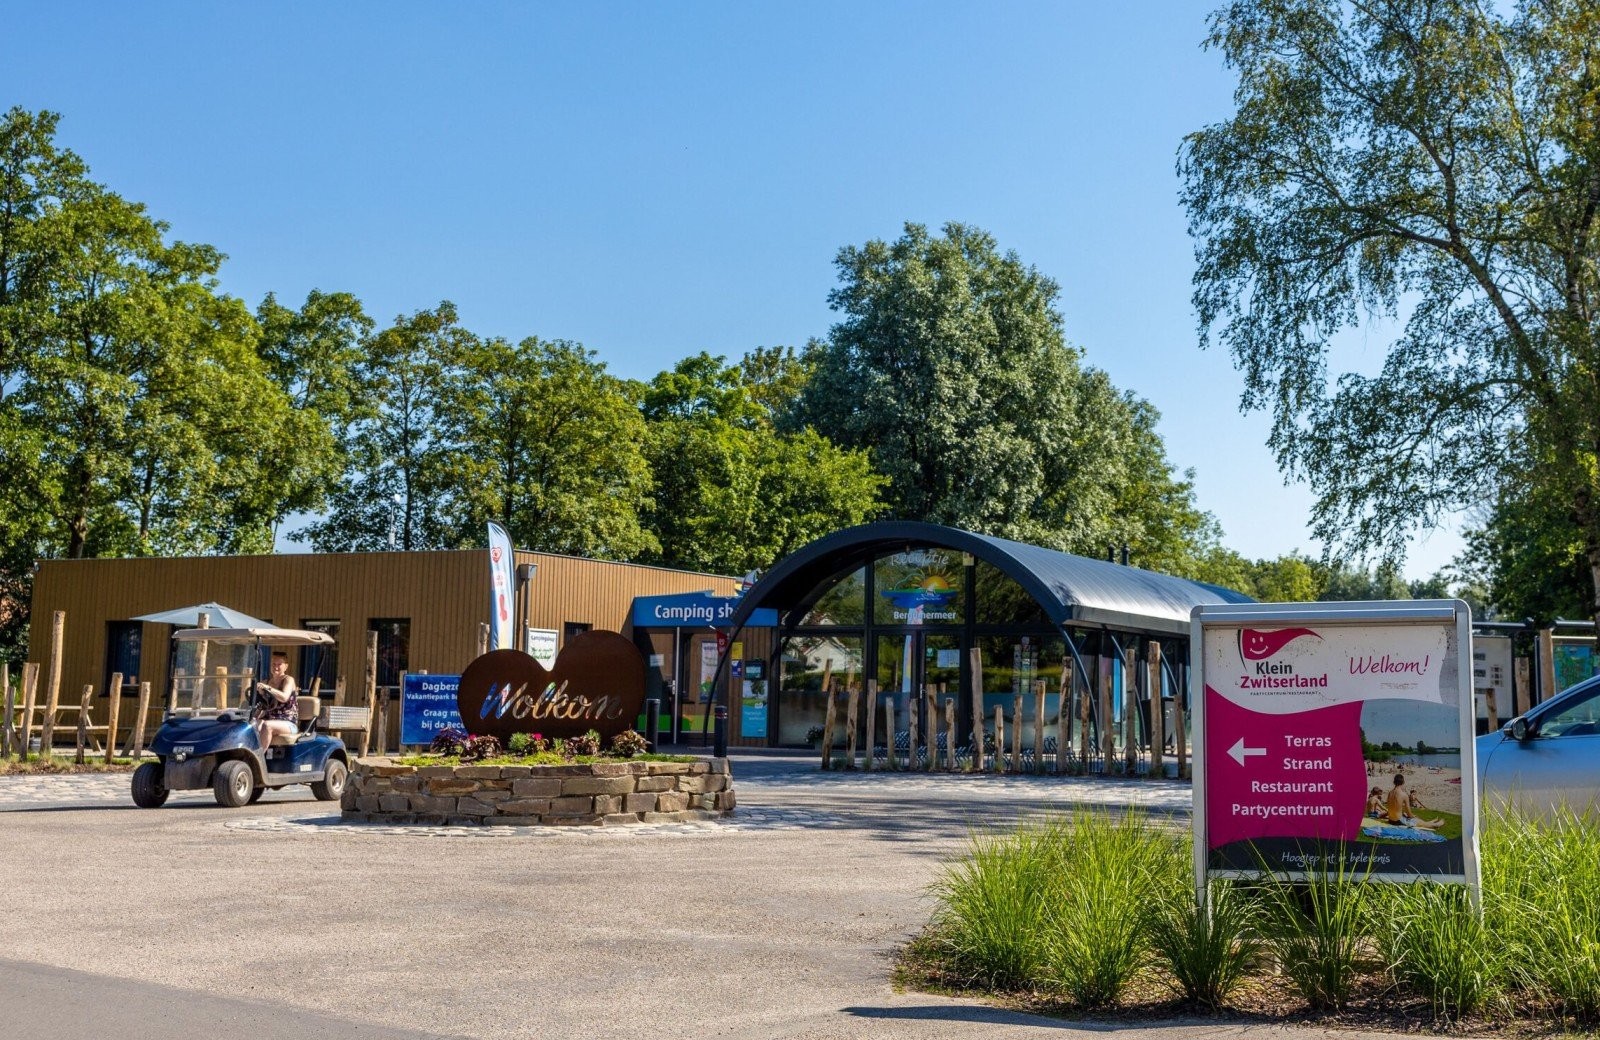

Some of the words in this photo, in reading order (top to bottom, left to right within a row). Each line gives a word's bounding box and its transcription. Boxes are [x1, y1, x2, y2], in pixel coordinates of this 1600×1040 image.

[655, 603, 714, 622] Camping
[1256, 661, 1293, 675] Klein
[1350, 654, 1429, 675] Welkom!
[422, 682, 460, 693] Dagbezo
[1240, 673, 1328, 689] Zwitserland
[406, 693, 450, 702] Vakantiepark
[423, 709, 448, 719] Graag
[421, 720, 433, 731] bij
[434, 720, 445, 729] de
[447, 721, 465, 729] Rece
[1284, 735, 1332, 747] Terras
[1283, 757, 1332, 770] Strand
[1251, 780, 1334, 793] Restaurant
[1232, 803, 1334, 819] Partycentrum
[1281, 852, 1337, 868] Hoogtepnt
